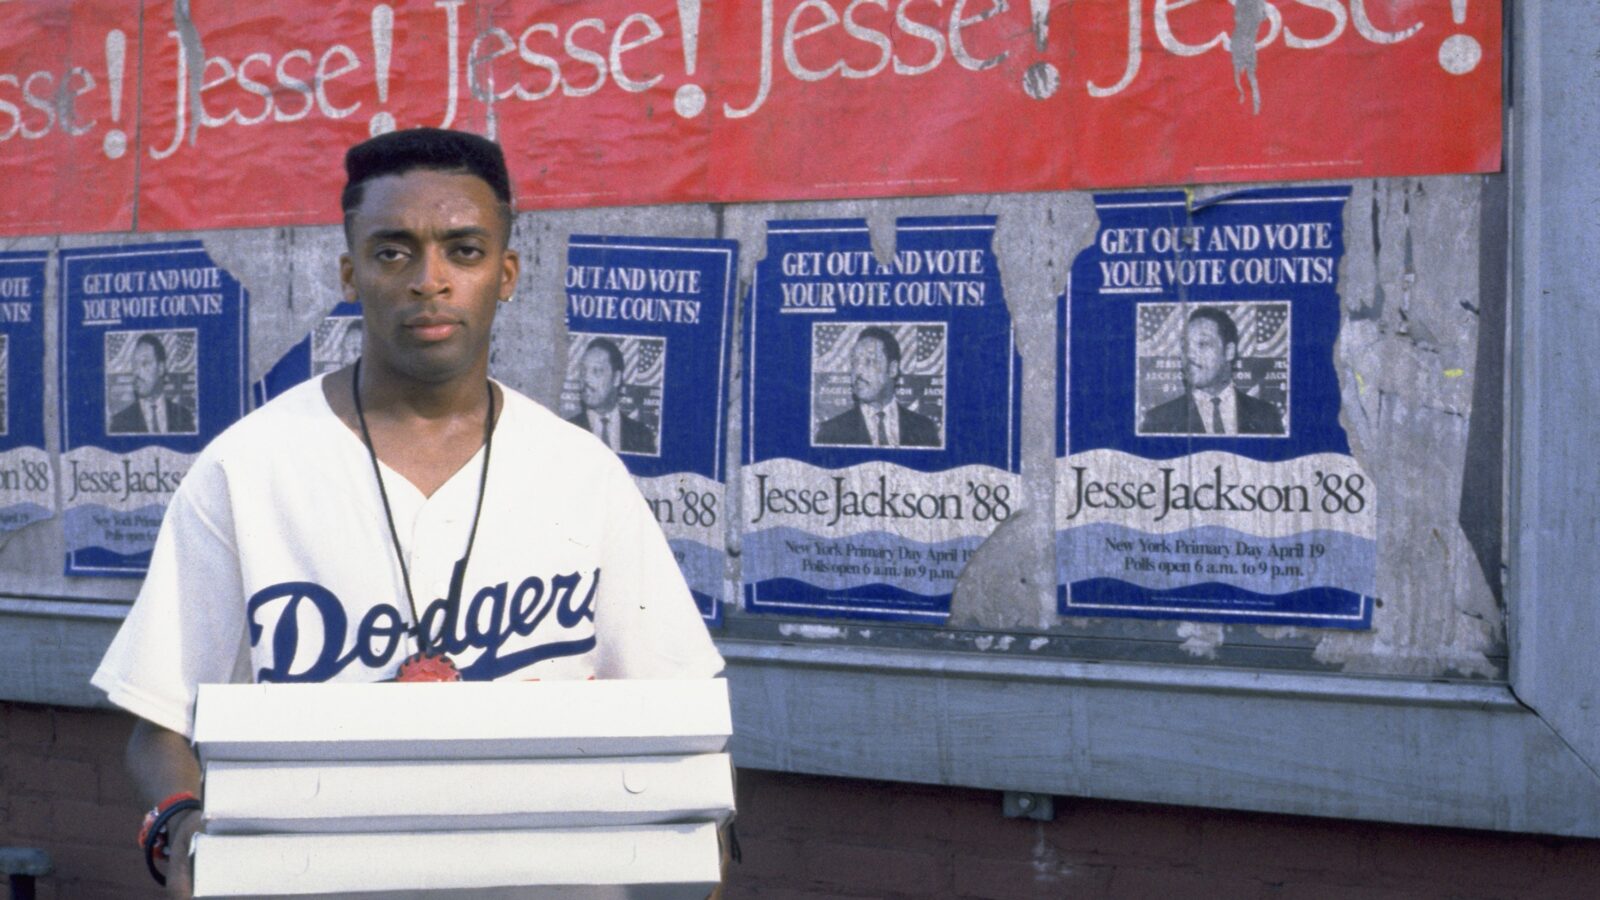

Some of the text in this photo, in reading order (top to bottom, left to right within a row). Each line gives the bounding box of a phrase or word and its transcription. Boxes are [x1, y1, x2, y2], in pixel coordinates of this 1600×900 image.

[150, 4, 395, 160] Jesse!
[414, 0, 706, 129] Jesse!
[723, 0, 1060, 118] Jesse!
[1100, 223, 1332, 254] GET OUT AND VOTE
[781, 252, 825, 277] GET
[826, 251, 871, 276] OUT
[924, 250, 985, 274] VOTE
[1099, 257, 1334, 287] YOUR VOTE COUNTS!
[83, 267, 221, 294] GET OUT AND VOTE
[564, 265, 701, 294] OUT AND VOTE
[83, 294, 223, 320] YOUR VOTE COUNTS!
[570, 294, 702, 324] VOTE COUNTS!
[780, 282, 985, 307] YOUR VOTE COUNTS!
[21, 459, 49, 492] '88
[68, 460, 121, 502] Jesse
[678, 487, 717, 528] '88
[751, 474, 1011, 527] Jesse Jackson '88
[1066, 465, 1366, 522] Jesse Jackson '88
[785, 540, 811, 554] New
[814, 541, 842, 556] York
[846, 543, 894, 561] Primary
[899, 546, 922, 563] Day
[927, 548, 957, 565] April
[1105, 537, 1325, 560] New York Primary Day April 19
[802, 558, 831, 573] Polls
[831, 562, 860, 577] open
[863, 563, 871, 575] 6
[873, 565, 899, 577] a.m.
[904, 566, 916, 578] to
[918, 566, 927, 578] 9
[1124, 556, 1304, 579] Polls open 6 a.m. to 9 p.m.
